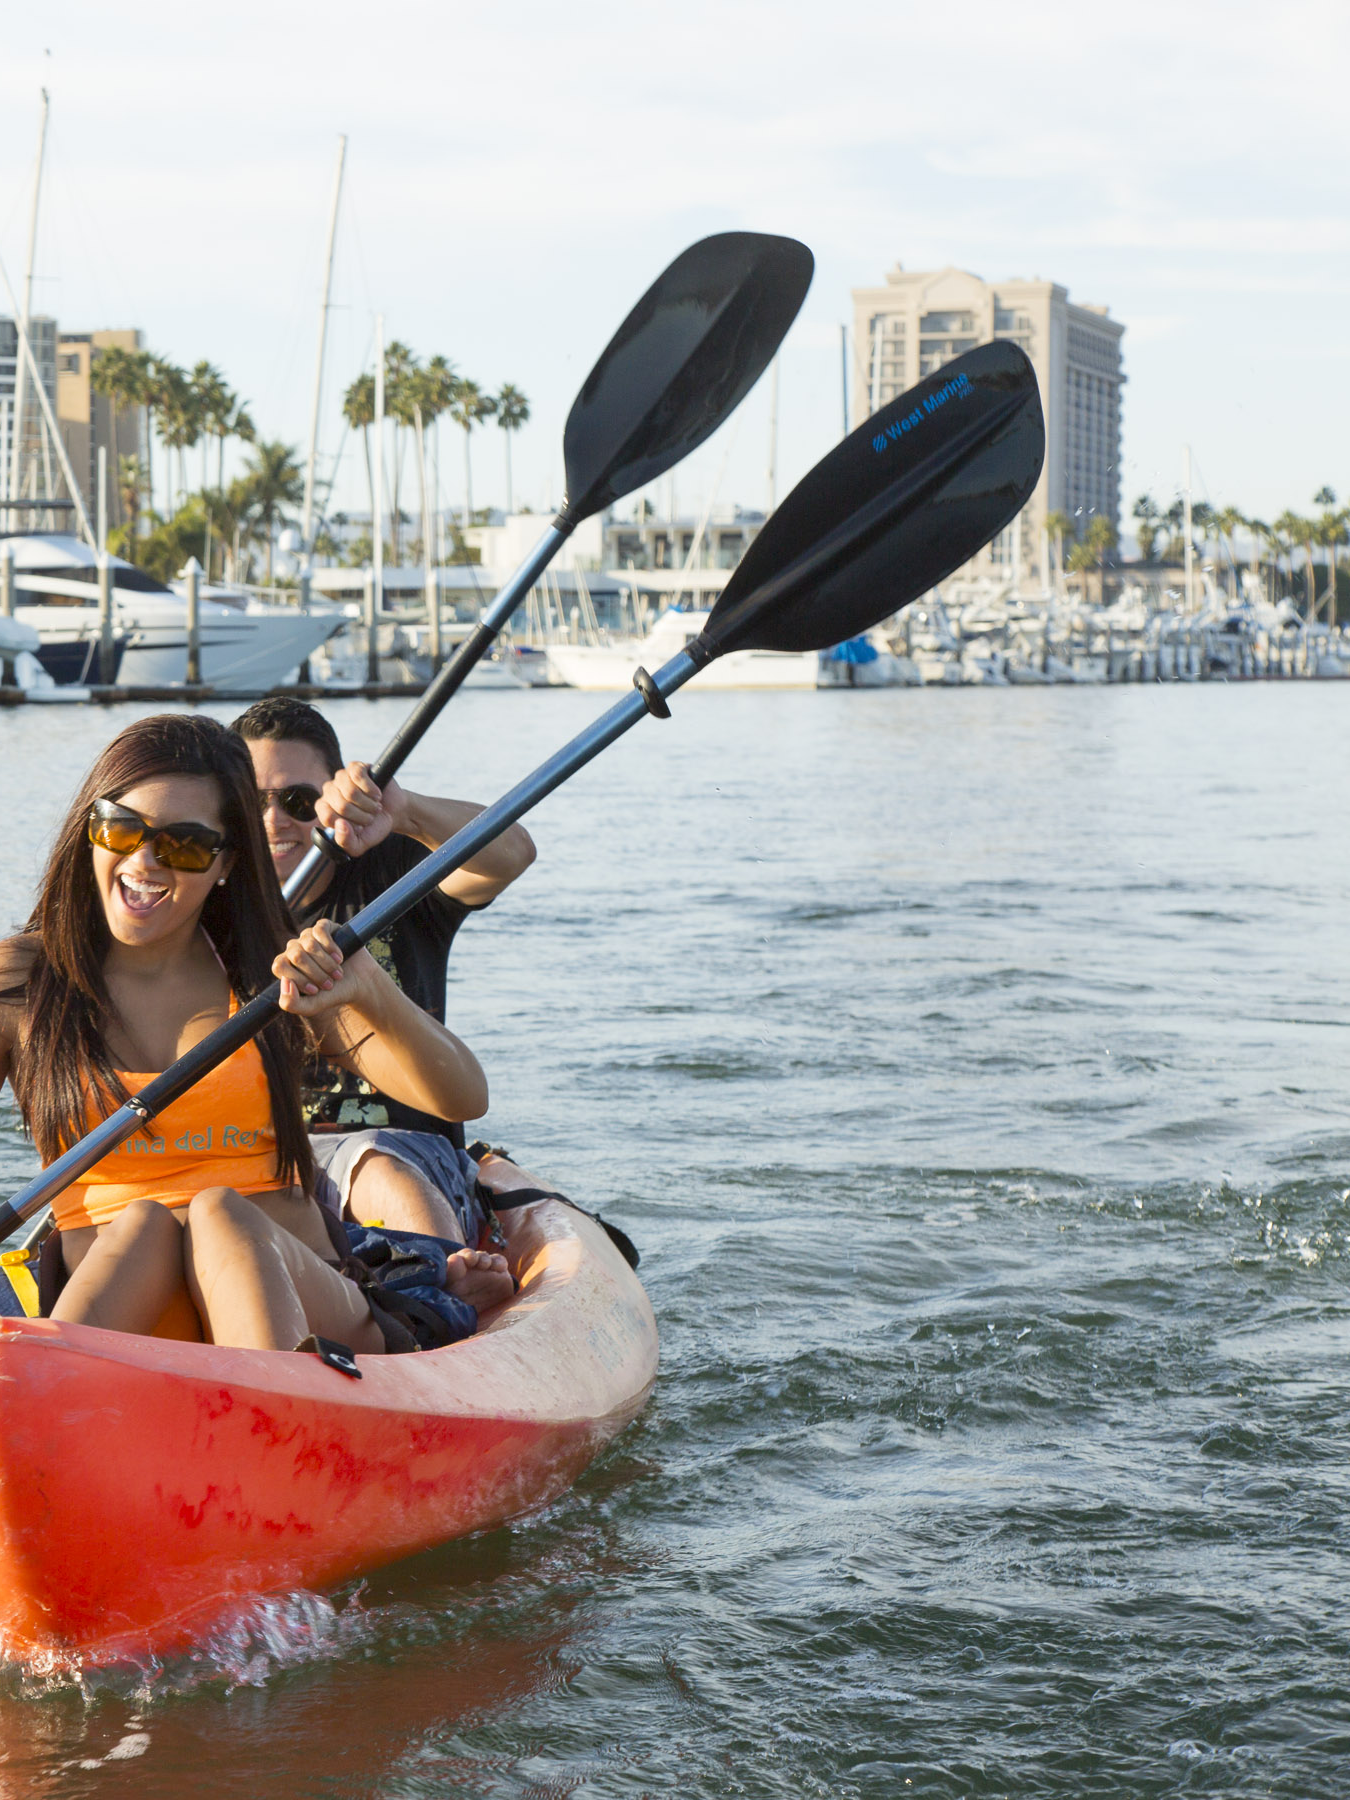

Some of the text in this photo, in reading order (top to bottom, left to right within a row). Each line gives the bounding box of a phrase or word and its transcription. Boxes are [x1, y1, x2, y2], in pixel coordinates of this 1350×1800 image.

[886, 373, 968, 440] West Marine
[174, 1126, 213, 1152] del
[222, 1124, 265, 1149] Rey
